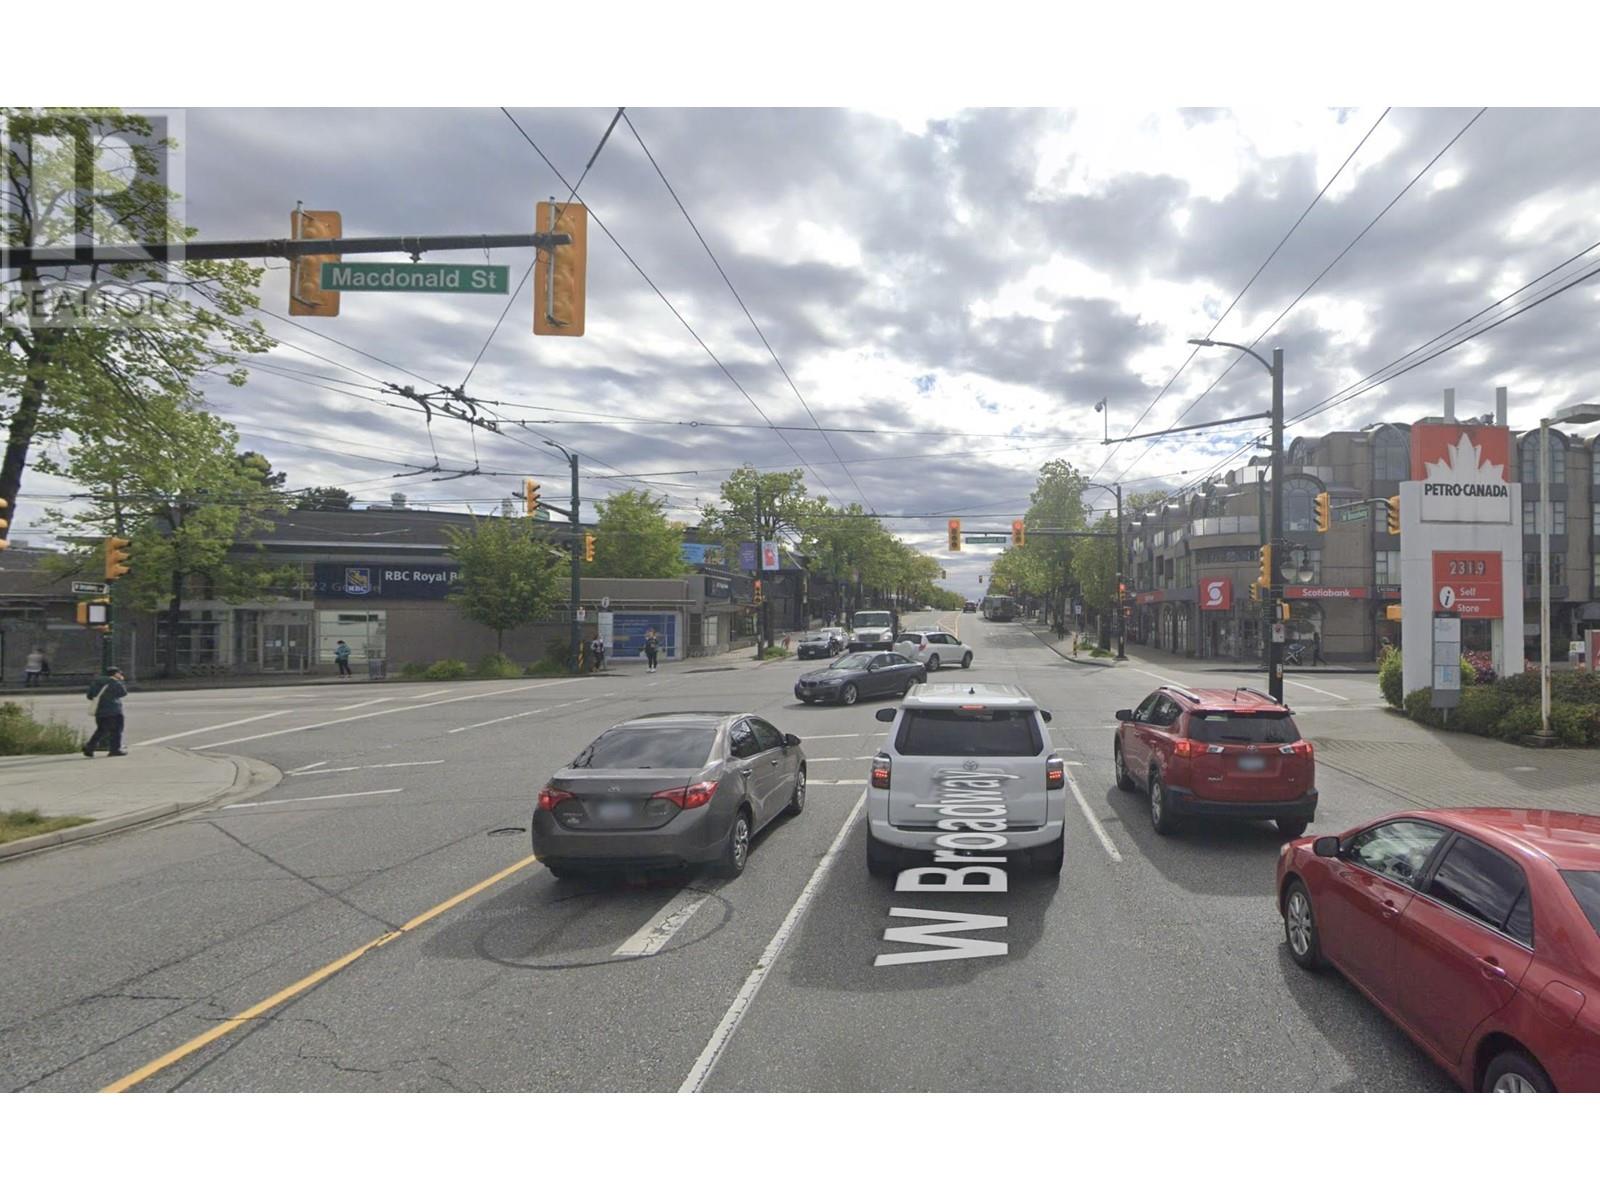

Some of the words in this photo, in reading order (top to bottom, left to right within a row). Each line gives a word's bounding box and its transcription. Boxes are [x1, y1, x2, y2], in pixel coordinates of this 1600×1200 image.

[332, 267, 460, 287] Macdonald
[471, 269, 496, 288] St
[385, 571, 410, 581] RBC
[413, 571, 446, 584] Royal
[1302, 588, 1351, 597] Scotiabank
[1460, 588, 1476, 596] Self
[1457, 604, 1480, 613] Store
